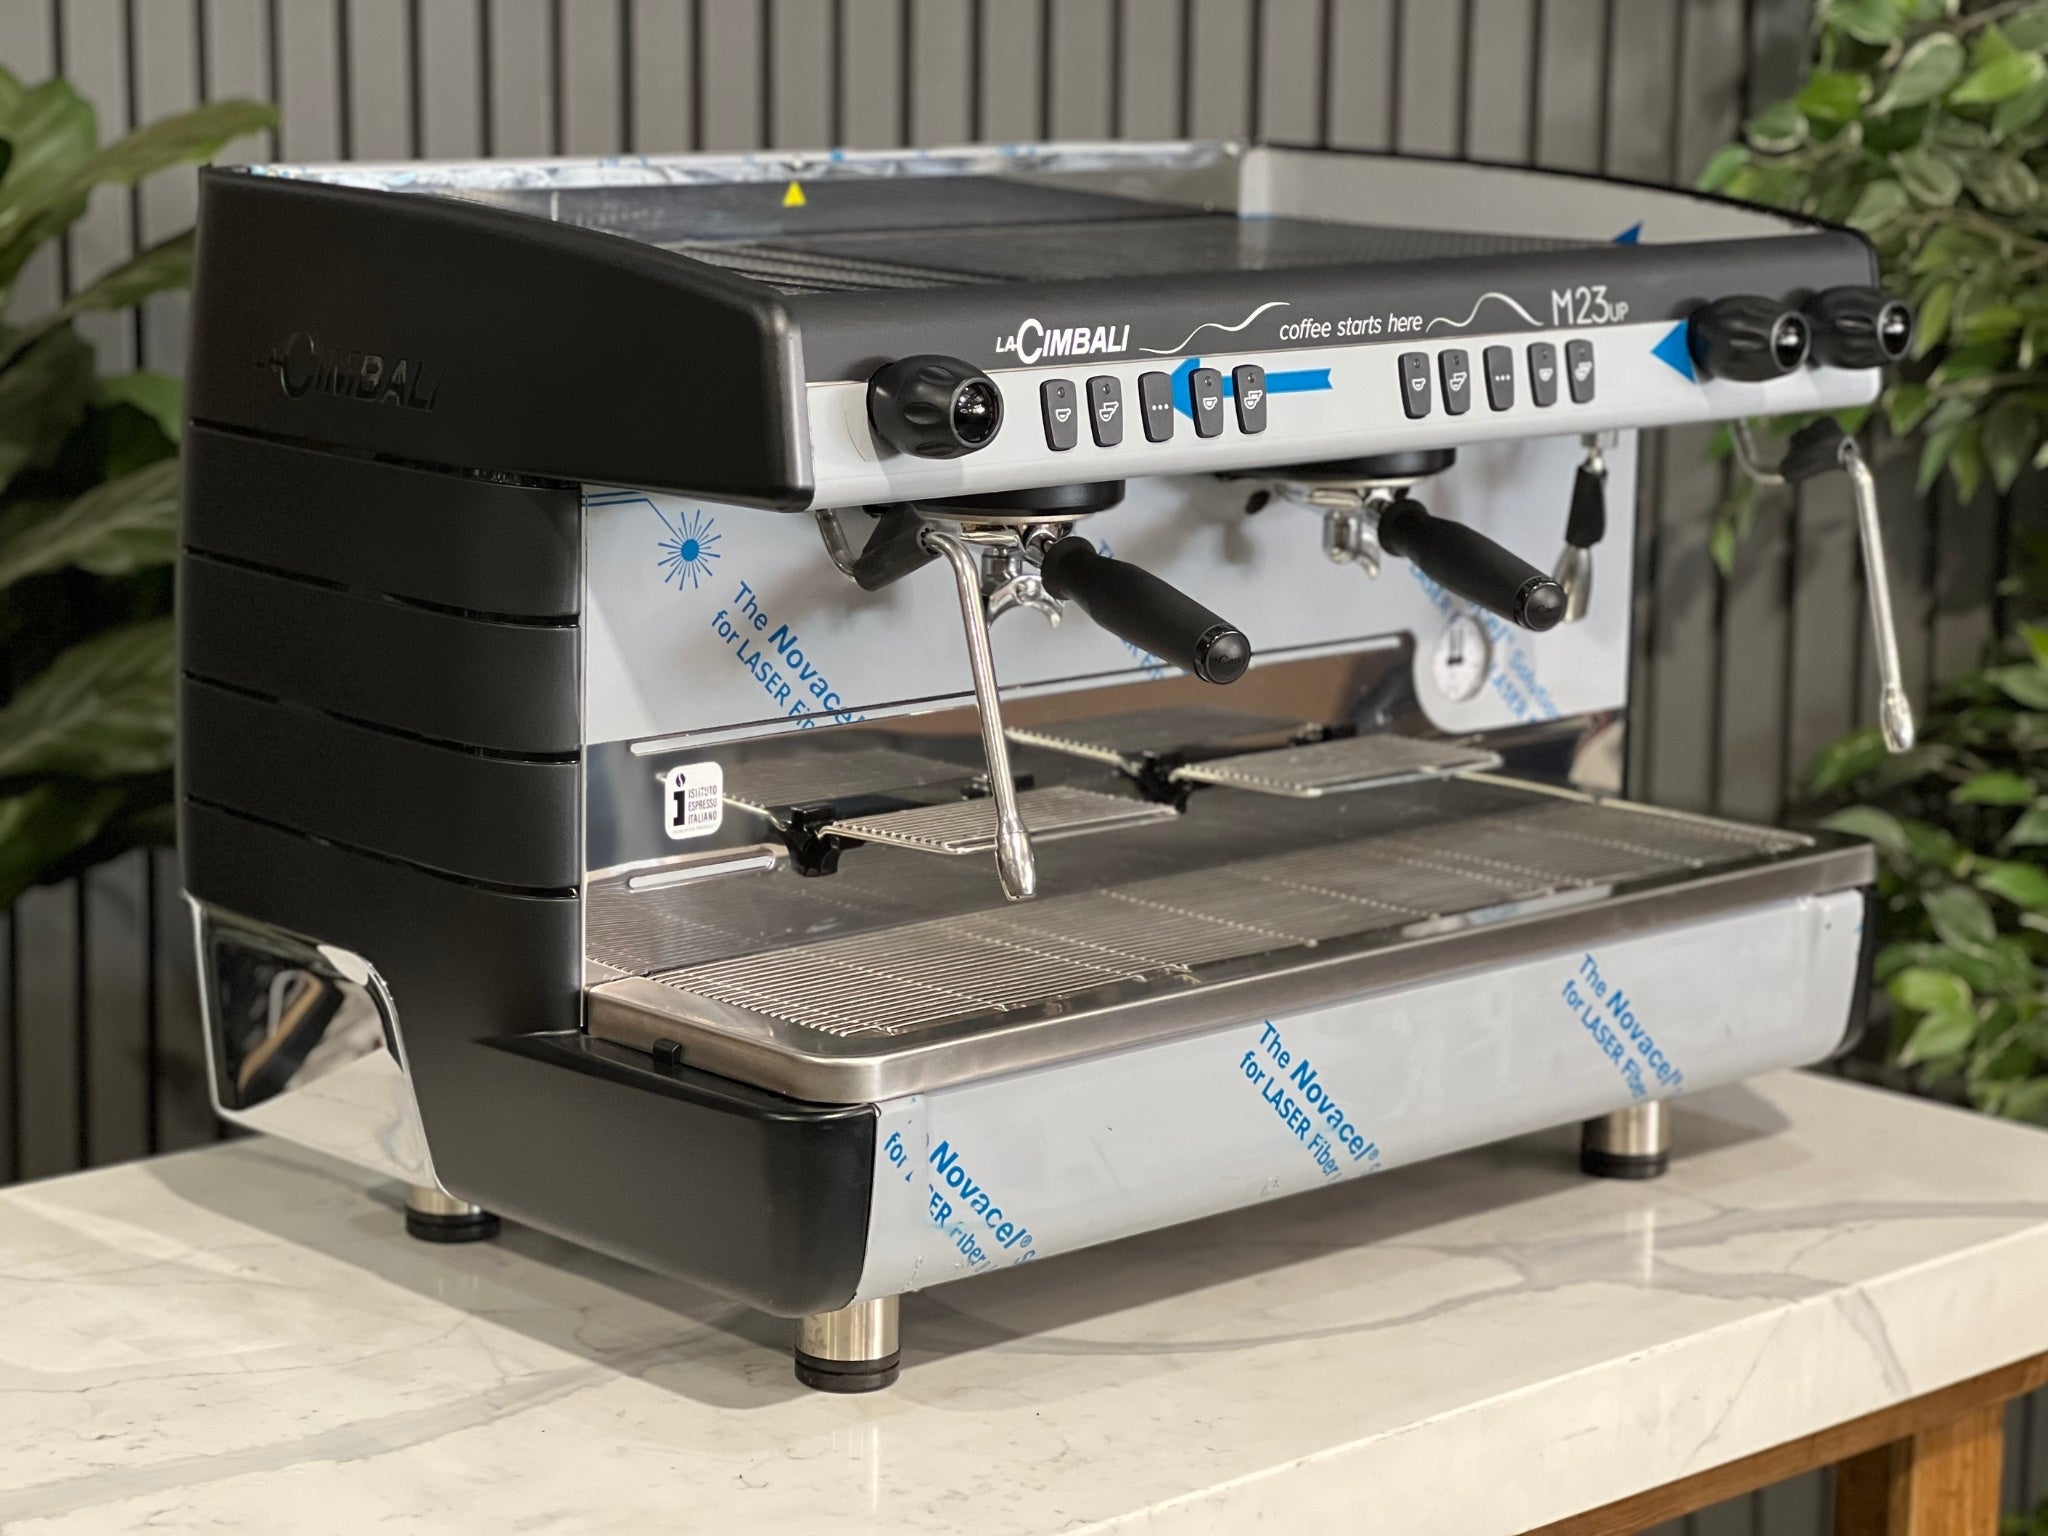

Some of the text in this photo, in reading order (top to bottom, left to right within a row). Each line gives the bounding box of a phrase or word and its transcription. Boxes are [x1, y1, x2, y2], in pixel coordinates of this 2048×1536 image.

[1016, 318, 1130, 365] CIMBALI
[1279, 313, 1423, 341] coffee starts here
[711, 609, 740, 644] for
[736, 639, 792, 707] LASER
[733, 580, 866, 726] The Novace
[688, 784, 718, 799] ISTITUTO
[688, 798, 718, 812] ESPRESSO
[688, 810, 718, 824] ITALIANO
[1562, 979, 1585, 1012] for
[1580, 953, 1607, 998] The
[1259, 1019, 1290, 1069] The
[1239, 1050, 1339, 1177] for LASER Fiber
